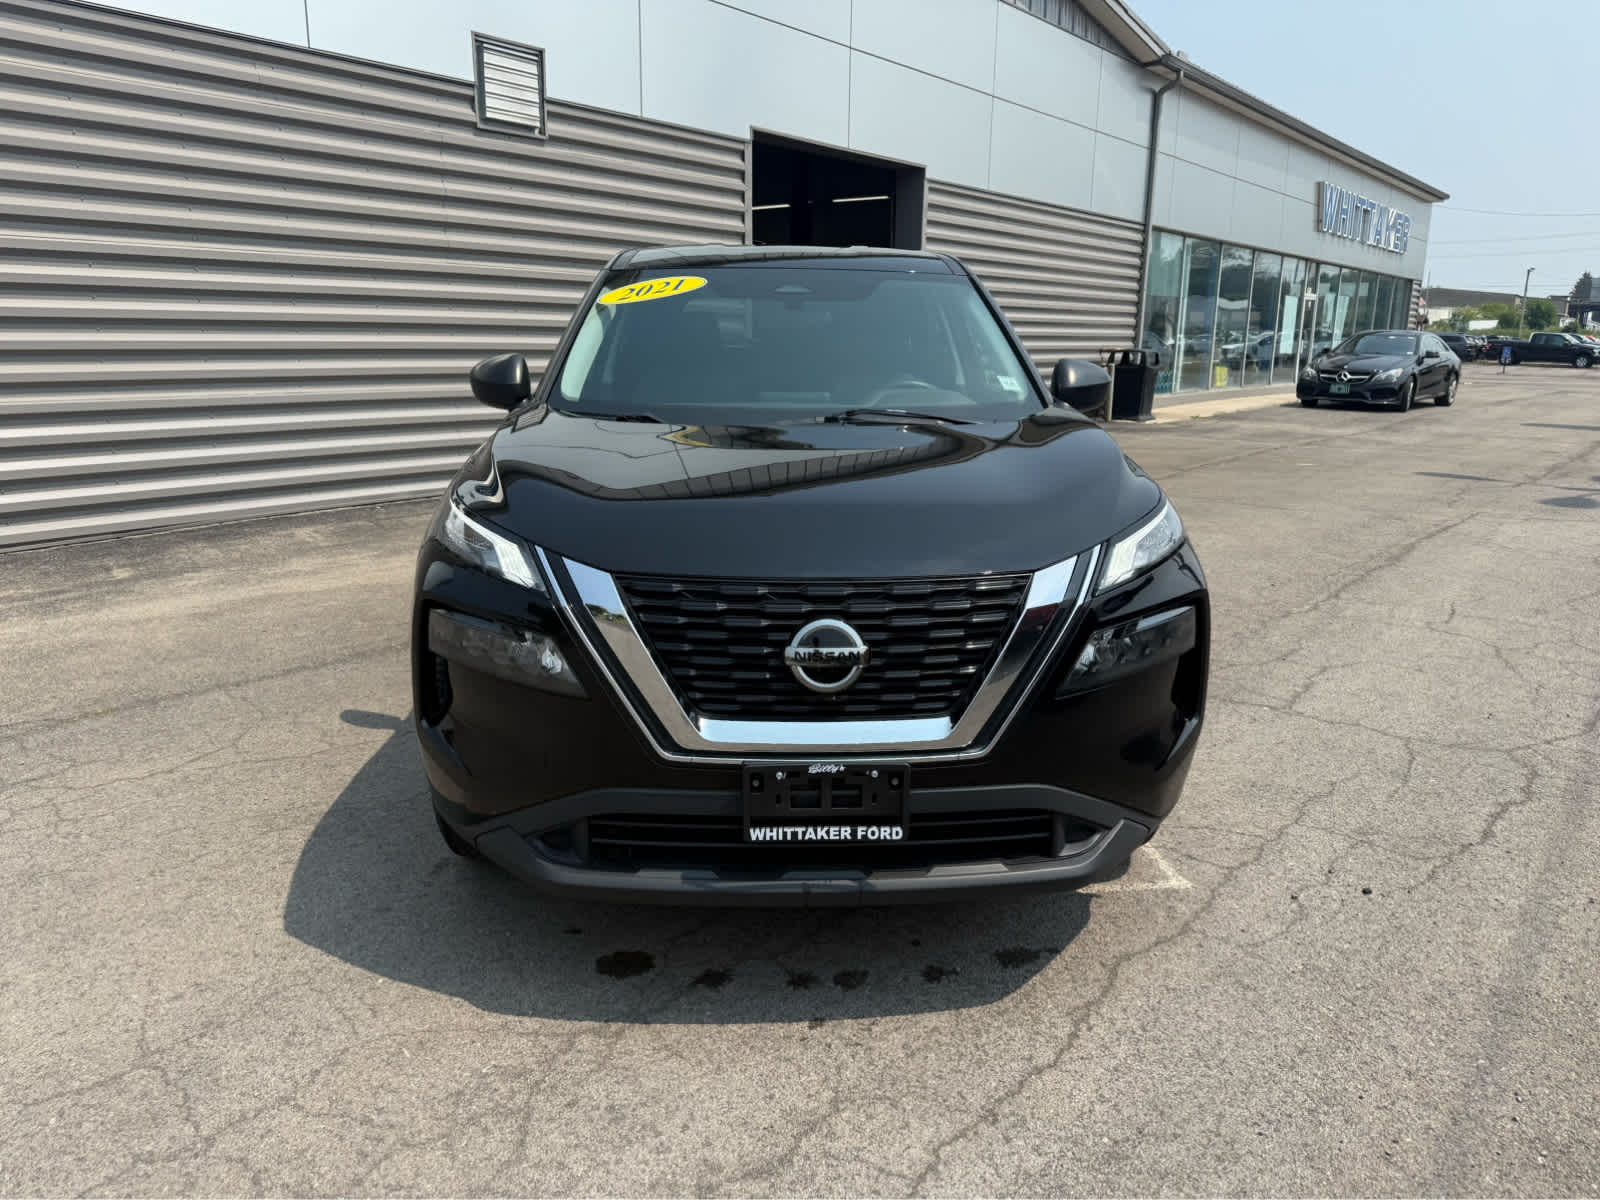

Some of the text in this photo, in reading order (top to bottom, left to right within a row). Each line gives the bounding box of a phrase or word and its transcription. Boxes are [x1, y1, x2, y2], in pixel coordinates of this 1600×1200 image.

[1322, 181, 1411, 254] WHITTAKER
[615, 279, 686, 301] 2021
[793, 651, 861, 663] NISSAN
[750, 826, 903, 841] WHITTAKER FORD
